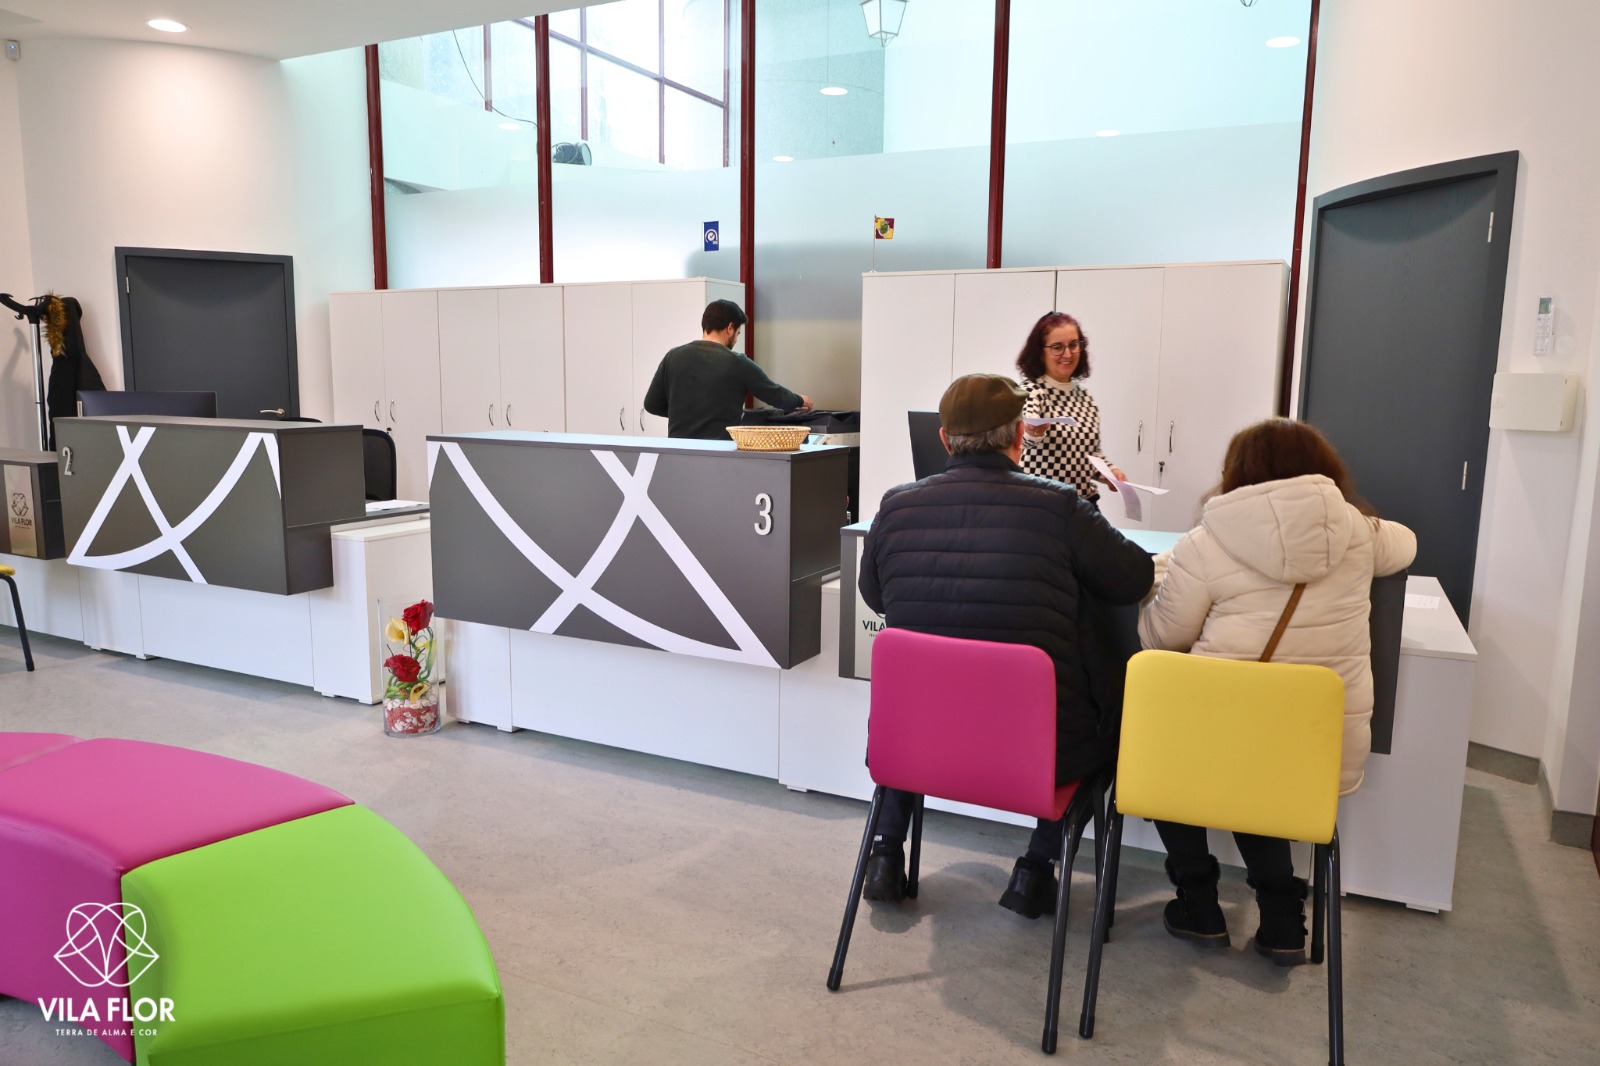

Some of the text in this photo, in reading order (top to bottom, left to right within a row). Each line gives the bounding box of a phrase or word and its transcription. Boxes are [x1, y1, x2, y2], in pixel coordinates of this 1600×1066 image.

[62, 446, 73, 476] 2
[22, 518, 33, 527] FLOR
[754, 492, 772, 536] 3
[862, 619, 885, 632] VILA
